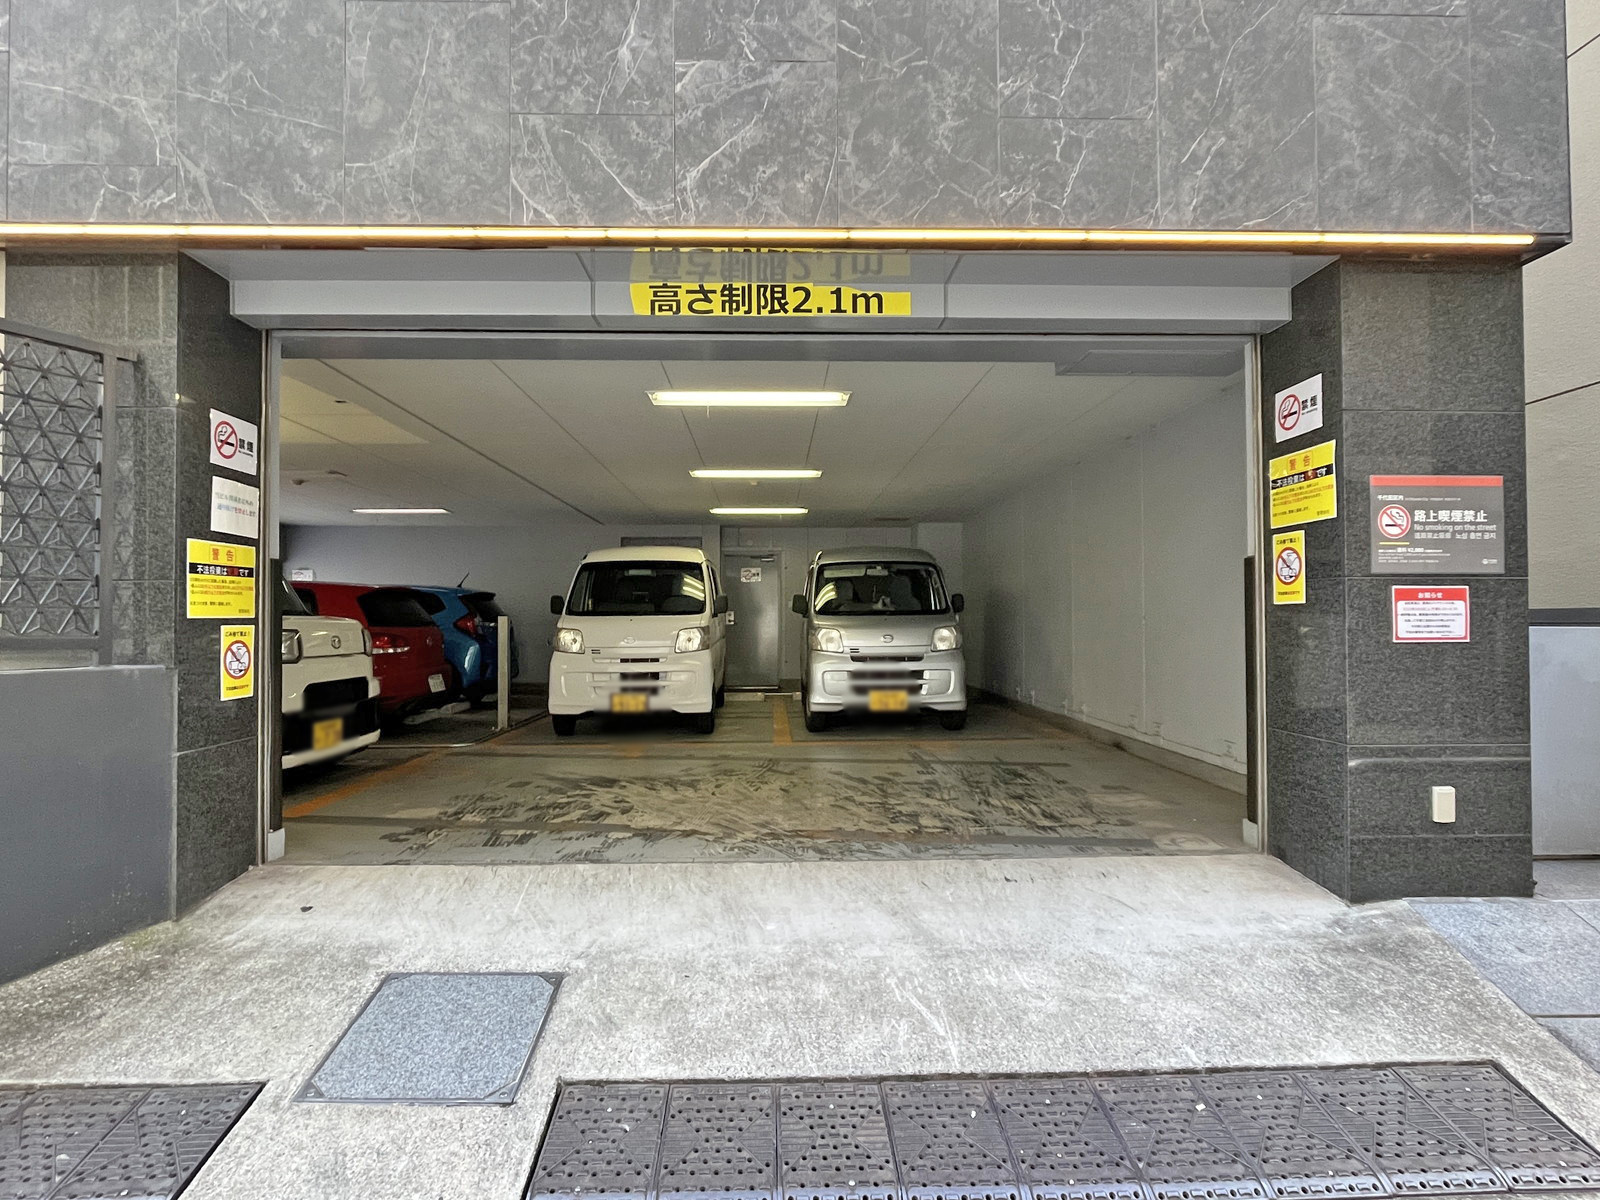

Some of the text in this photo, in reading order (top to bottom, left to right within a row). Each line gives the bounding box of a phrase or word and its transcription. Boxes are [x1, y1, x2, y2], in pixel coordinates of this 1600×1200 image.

[648, 283, 884, 316] 高さ制限2.1m
[1413, 509, 1488, 522] 路上喫煙禁止
[1425, 523, 1453, 532] smoking
